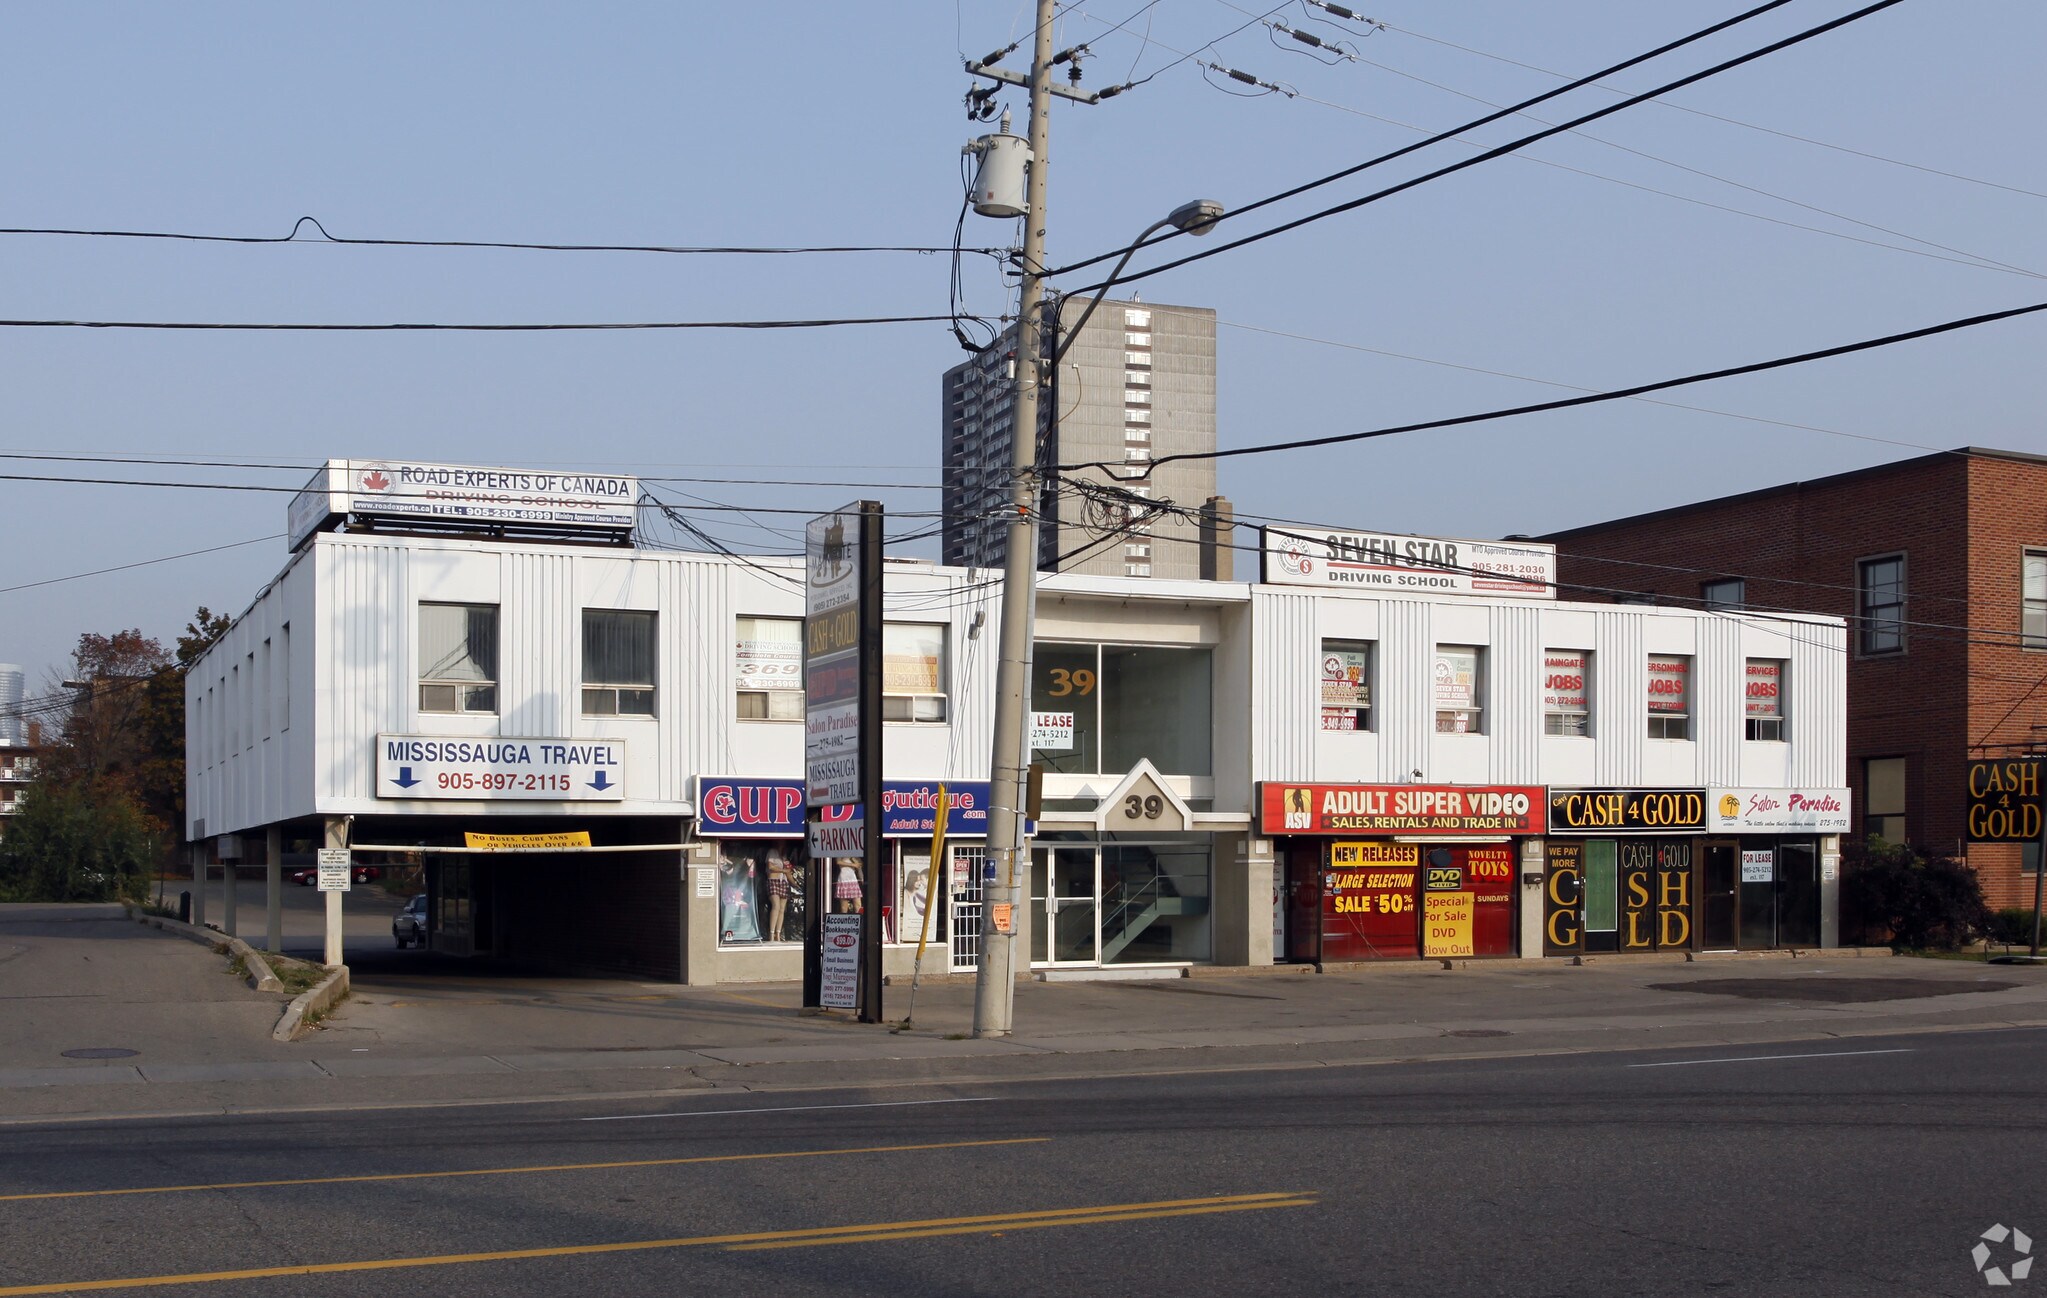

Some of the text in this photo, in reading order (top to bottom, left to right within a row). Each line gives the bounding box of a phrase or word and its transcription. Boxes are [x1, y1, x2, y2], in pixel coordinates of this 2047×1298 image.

[401, 466, 629, 496] ROAD EXPERTS OF CANADA
[426, 490, 606, 510] DRIVING SCHOOL
[354, 502, 552, 520] www.roadexperts.ca TEL: 905-230-6999
[555, 512, 632, 524] Ministry Approved Course Provider
[1326, 535, 1458, 571] SEVEN STAR
[1471, 545, 1483, 554] MTO
[1484, 547, 1507, 556] Approved
[1472, 562, 1545, 574] 905-281-2030
[1329, 571, 1458, 589] DRIVING SCHOOL
[809, 619, 828, 655] CASH
[836, 611, 857, 647] GOLD
[741, 664, 800, 675] 369
[1648, 662, 1688, 673] ERSONNEL
[1746, 666, 1779, 676] ERVICES
[737, 680, 800, 688] 90230-6999
[885, 674, 936, 687] 905-230-6999
[1048, 668, 1096, 697] 39
[1545, 674, 1583, 690] JOBS
[1648, 679, 1684, 695] JOBS
[1746, 682, 1777, 697] JOBS
[808, 711, 857, 736] Salon Paradise
[1037, 714, 1072, 728] LEASE
[1030, 730, 1068, 739] -274-5212
[387, 741, 618, 766] MISSISSAUGA TRAVEL
[809, 758, 855, 782] MISSISSAUGA
[437, 772, 571, 791] 905-897-2115
[1969, 763, 2039, 798] CASH
[829, 781, 855, 800] TRAVEL
[703, 785, 855, 824] CUPD
[881, 787, 986, 819] outiue .com
[1125, 795, 1163, 819] 39
[1322, 791, 1529, 815] ADULT SUPER VIDEO
[1552, 794, 1568, 807] Cavi
[1744, 793, 1842, 817] Salon Paradise
[1998, 794, 2010, 808] 4
[1566, 794, 1702, 826] CASH 4 GOLD
[890, 819, 918, 829] Adult
[1285, 812, 1311, 829] ASV
[1431, 817, 1460, 828] AND
[1463, 817, 1501, 828] TRADE
[1504, 818, 1517, 828] IN
[1969, 804, 2041, 838] GOLD
[1335, 847, 1416, 862] NEW RELEASES
[1468, 851, 1508, 859] NOVELTY
[1563, 848, 1579, 856] PAY
[1622, 844, 1690, 868] CASH 4 GOLD
[1743, 853, 1771, 863] FOR LEASE
[1468, 861, 1509, 876] TOYS
[1551, 859, 1576, 867] MORE
[1335, 874, 1415, 888] LARGE SELECTION
[1429, 869, 1460, 882] DVD
[1335, 896, 1370, 913] SALE
[1426, 896, 1465, 908] Special
[826, 915, 859, 926] Accounting
[1424, 911, 1467, 921] For Sale
[825, 926, 859, 935] Bookkeeping
[1432, 928, 1456, 938] DVD
[836, 937, 854, 945] $99.00
[1451, 945, 1470, 954] Out
